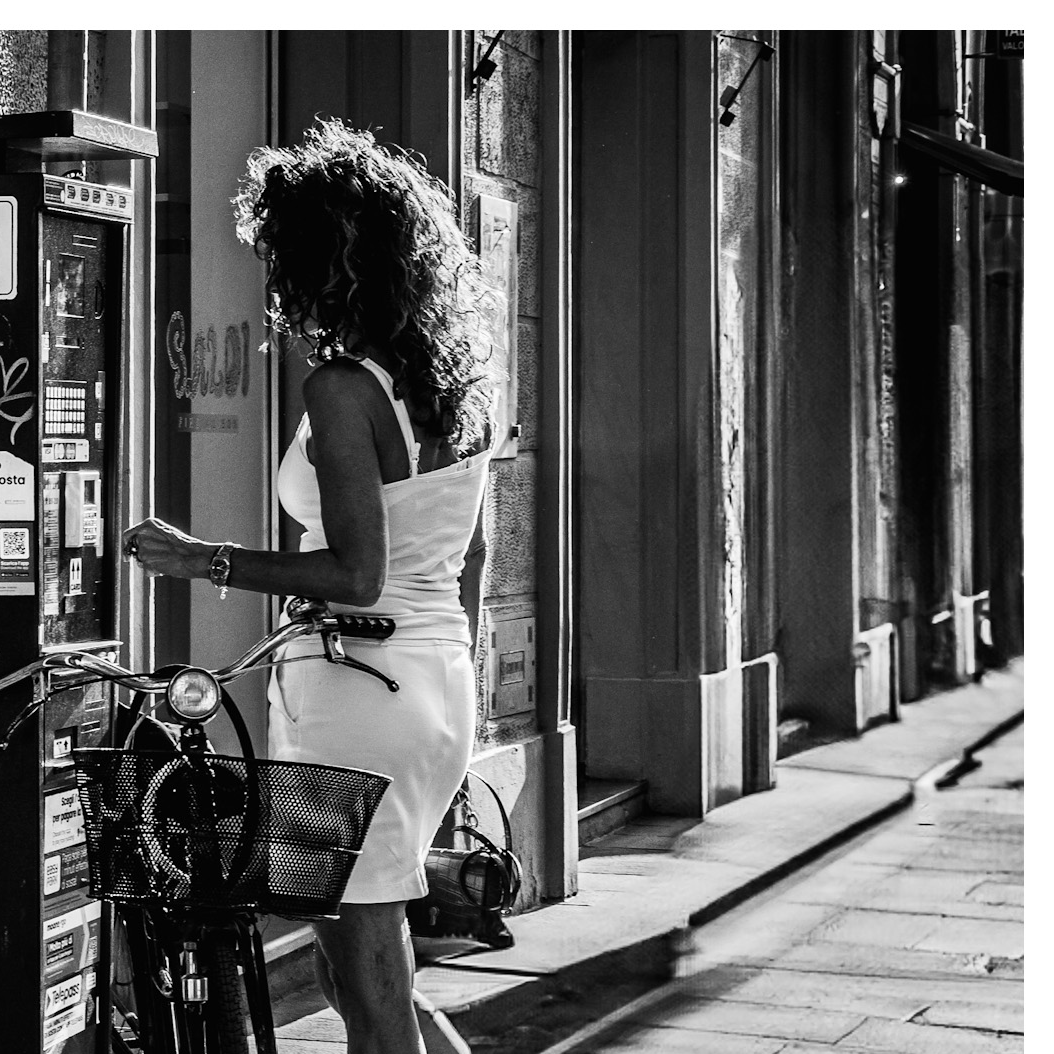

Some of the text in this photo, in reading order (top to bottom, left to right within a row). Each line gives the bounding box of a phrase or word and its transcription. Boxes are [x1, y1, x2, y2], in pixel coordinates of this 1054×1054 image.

[61, 793, 74, 808] Scegli
[52, 814, 61, 826] per
[60, 810, 77, 825] pagare
[52, 983, 80, 1006] Telepass
